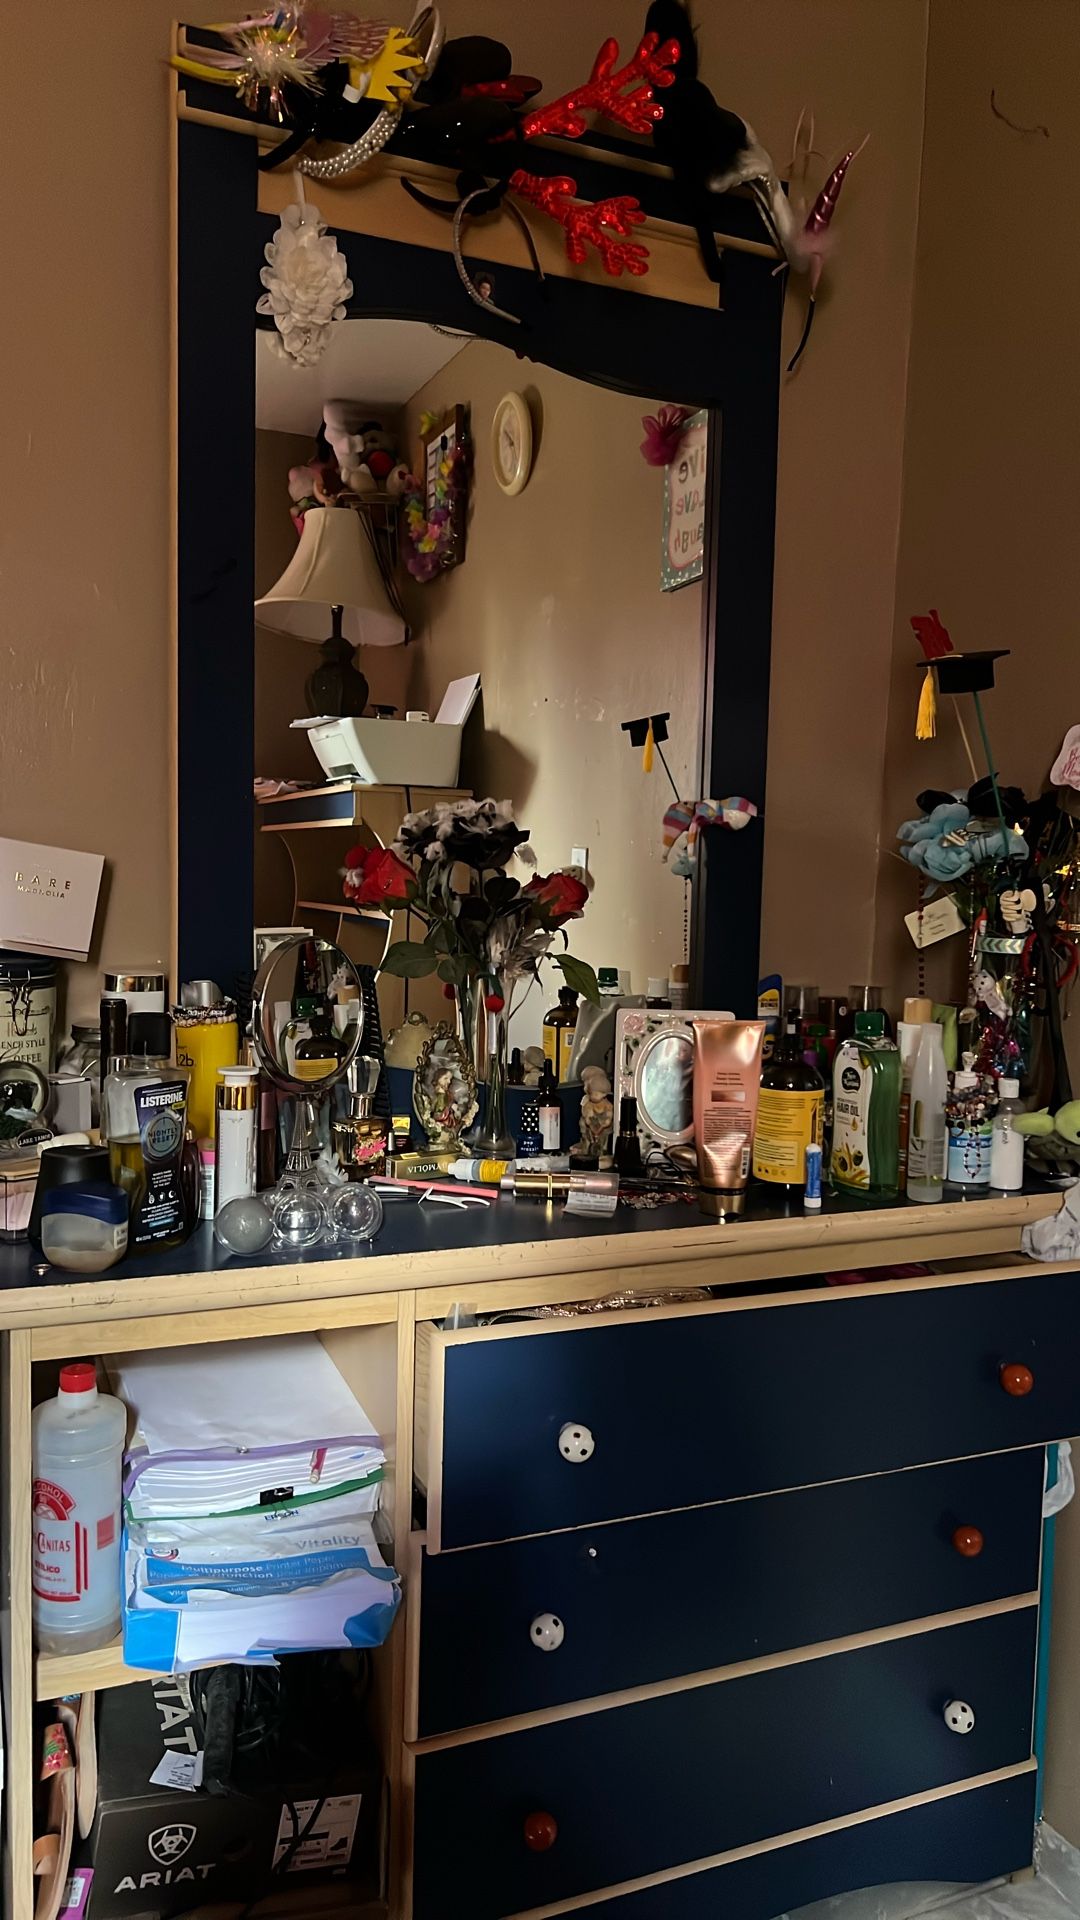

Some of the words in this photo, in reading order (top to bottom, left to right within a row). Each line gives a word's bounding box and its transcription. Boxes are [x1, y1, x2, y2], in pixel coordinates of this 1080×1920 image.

[15, 871, 71, 890] BARE
[1, 1041, 24, 1049] ENCH
[26, 1037, 46, 1048] STYLE
[14, 1053, 42, 1063] OFFEE
[140, 1091, 184, 1109] LISTERINE
[836, 1102, 849, 1115] HAIR
[850, 1104, 860, 1117] OIL
[407, 1161, 447, 1174] YMOLIA
[36, 1482, 64, 1504] COHOL
[264, 1509, 299, 1521] EPSON
[297, 1535, 360, 1551] Vitality
[181, 1564, 263, 1575] Multipurpose
[150, 1676, 198, 1753] IAT
[113, 1863, 217, 1894] ARIAT
